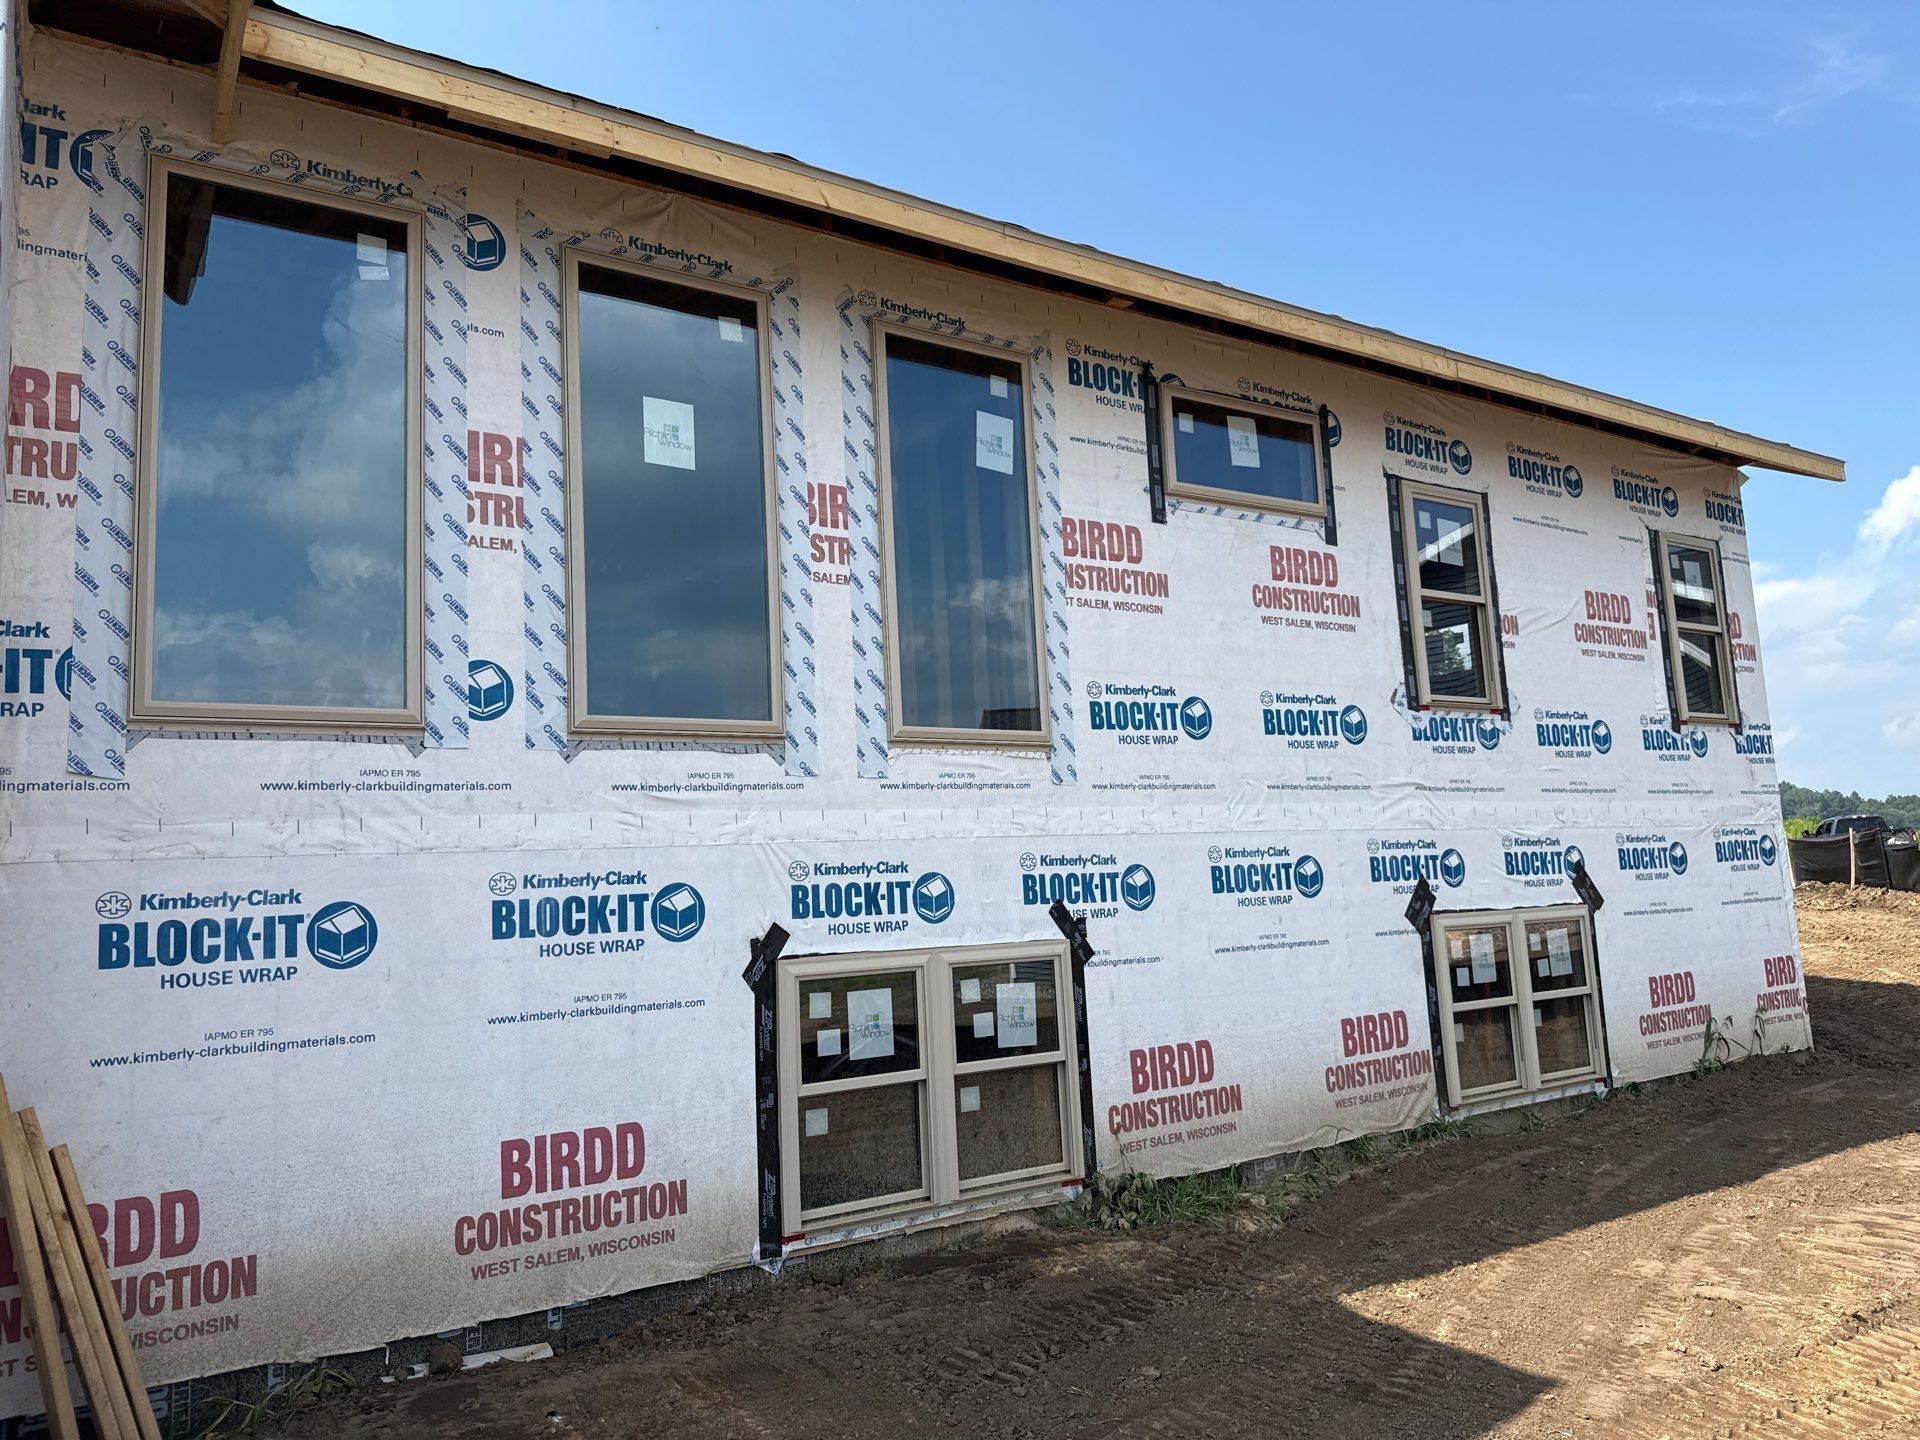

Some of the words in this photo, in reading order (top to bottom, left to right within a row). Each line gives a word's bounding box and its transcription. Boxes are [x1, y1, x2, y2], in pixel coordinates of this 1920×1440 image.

[628, 235, 733, 274] Kimberly-Clark
[880, 297, 966, 328] Kimberly-Clark
[1084, 344, 1154, 370] Kimberly-Clark
[1068, 357, 1145, 400] BLOCK-I
[1095, 395, 1127, 410] HOUSE
[1253, 381, 1312, 405] Kimberly-Clark
[1396, 415, 1446, 437] Kimberly-Clark
[658, 438, 693, 451] Window
[1385, 427, 1448, 463] BLOCK-IT
[1516, 445, 1560, 463] Kimberly-Clark
[1405, 458, 1429, 470] HOUSE
[1429, 463, 1448, 475] WRAP
[1507, 455, 1562, 488] BLOCK-IT
[1620, 468, 1659, 485] Kimberly-Clark
[1526, 484, 1546, 495] HOUSE
[1546, 487, 1563, 498] WRAP
[1613, 479, 1661, 508] BLOCK-IT
[1629, 505, 1647, 515] HOUSE
[1647, 509, 1662, 518] WRAP
[1061, 517, 1143, 565] BIRDD
[1269, 545, 1338, 588] BIRDD
[1064, 563, 1169, 599] NSTRUCTION
[1076, 598, 1111, 612] SALEM,
[1113, 601, 1163, 615] WISCONSIN
[1252, 583, 1361, 618] CONSTRUCTION
[1585, 590, 1632, 625] BIRDD
[1260, 616, 1283, 627] WEST
[1314, 620, 1356, 633] WISCONSIN
[1574, 623, 1648, 650] CONSTRUCTION
[1580, 649, 1597, 659] WEST
[1617, 653, 1646, 662] WISCONSIN
[1105, 684, 1176, 699] Kimberly-Clark
[1275, 693, 1336, 707] Kimberly-Clark
[1088, 701, 1178, 731] BLOCK-IT
[1262, 708, 1339, 736] BLOCK-IT
[1545, 710, 1588, 721] Kimberly-Clark
[1118, 735, 1150, 745] HOUSE
[1152, 734, 1179, 745] WRAP
[1287, 739, 1315, 750] HOUSE
[1317, 739, 1339, 750] WRAP
[1536, 723, 1590, 747] BLOCK-IT
[1432, 746, 1456, 754] HOUSE
[1457, 746, 1476, 754] WRAP
[1555, 750, 1575, 758] HOUSE
[1576, 750, 1592, 758] WRAP
[1658, 754, 1676, 762] HOUSE
[1677, 754, 1691, 762] WRAP
[360, 769, 387, 777] IAPMO
[389, 769, 403, 777] ER
[405, 769, 421, 777] 795
[687, 772, 710, 780] IAPMO
[711, 772, 723, 780] ER
[724, 772, 735, 780] 795
[260, 780, 512, 794] www.kimberly-clarkbuildingmaterials.com
[611, 781, 804, 793] www.kimberly-clarkbuildingmaterials.com
[880, 782, 1030, 791] www.kimberly-clarkbuildingmaterials.com
[1092, 782, 1216, 791] www.kimberly-clarkbuildingmaterials.com
[1514, 837, 1561, 848] Kimberly-Clark
[1626, 834, 1666, 845] Kimberly-Clark
[1721, 828, 1757, 838] Kimberly-Clark
[1224, 846, 1290, 859] Kimberly-Clark
[1381, 840, 1437, 851] Kimberly-Clark
[1715, 839, 1759, 863] BLOCK-IT
[813, 861, 909, 878] Kimberly-Clark
[1040, 854, 1117, 868] Kimberly-Clark
[1369, 855, 1439, 883] BLOCK-IT
[1504, 851, 1563, 876] BLOCK-IT
[1618, 847, 1668, 871] BLOCK-IT
[1747, 863, 1760, 871] WRAP
[523, 870, 647, 890] Kimberly-Clark
[1210, 862, 1293, 894] BLOCK-IT
[1524, 879, 1546, 888] HOUSE
[1548, 878, 1563, 887] WRAP
[1635, 873, 1653, 881] HOUSE
[1654, 872, 1669, 880] WRAP
[1022, 871, 1120, 905] BLOCK-IT
[140, 889, 302, 912] Kimberly-Clark
[791, 881, 912, 919] BLOCK-IT
[1237, 896, 1267, 907] HOUSE
[1268, 895, 1293, 906] WRAP
[491, 893, 650, 940] BLOCK-IT
[1090, 907, 1119, 919] WRAP
[828, 922, 871, 936] HOUSE
[874, 920, 909, 933] WRAP
[98, 915, 305, 969] BLOCK-IT
[539, 942, 595, 958] HOUSE
[599, 938, 645, 953] WRAP
[1214, 939, 1330, 955] www.kimberly-clarkbuildingmaterials.com
[160, 971, 233, 989] HOUSE
[238, 966, 298, 985] WRAP
[1763, 955, 1796, 988] BIRD
[573, 995, 599, 1003] IAPMO
[601, 993, 612, 1002] ER
[614, 992, 627, 1001] 795
[1648, 971, 1696, 1009] BIRDD
[487, 998, 705, 1025] www.kimberly-clarkbuildingmaterials.com
[1639, 1004, 1712, 1036] CONSTRUCTION
[204, 1031, 238, 1041] IAPMO
[240, 1029, 254, 1039] ER
[257, 1028, 274, 1037] 795
[1340, 1010, 1409, 1058] BIRDD
[90, 1032, 376, 1068] www.kimberly-clarkbuildingmaterials.com
[1646, 1040, 1662, 1050] WEST
[1129, 1039, 1214, 1094] BIRDD
[1325, 1049, 1432, 1093] CONSTRUCTION
[1334, 1097, 1358, 1110] WEST
[1387, 1082, 1429, 1100] WISCONSIN
[1108, 1084, 1242, 1136] CONSTRUCTION
[1120, 1139, 1148, 1154] WEST
[1149, 1133, 1185, 1147] SALEM,
[1187, 1121, 1237, 1142] WISCONSIN
[500, 1121, 645, 1199] BIRDD
[455, 1179, 687, 1255] CONSTRUCTION
[471, 1259, 520, 1281] WEST
[524, 1247, 585, 1270] SALEM,
[588, 1228, 676, 1258] WISCONSIN
